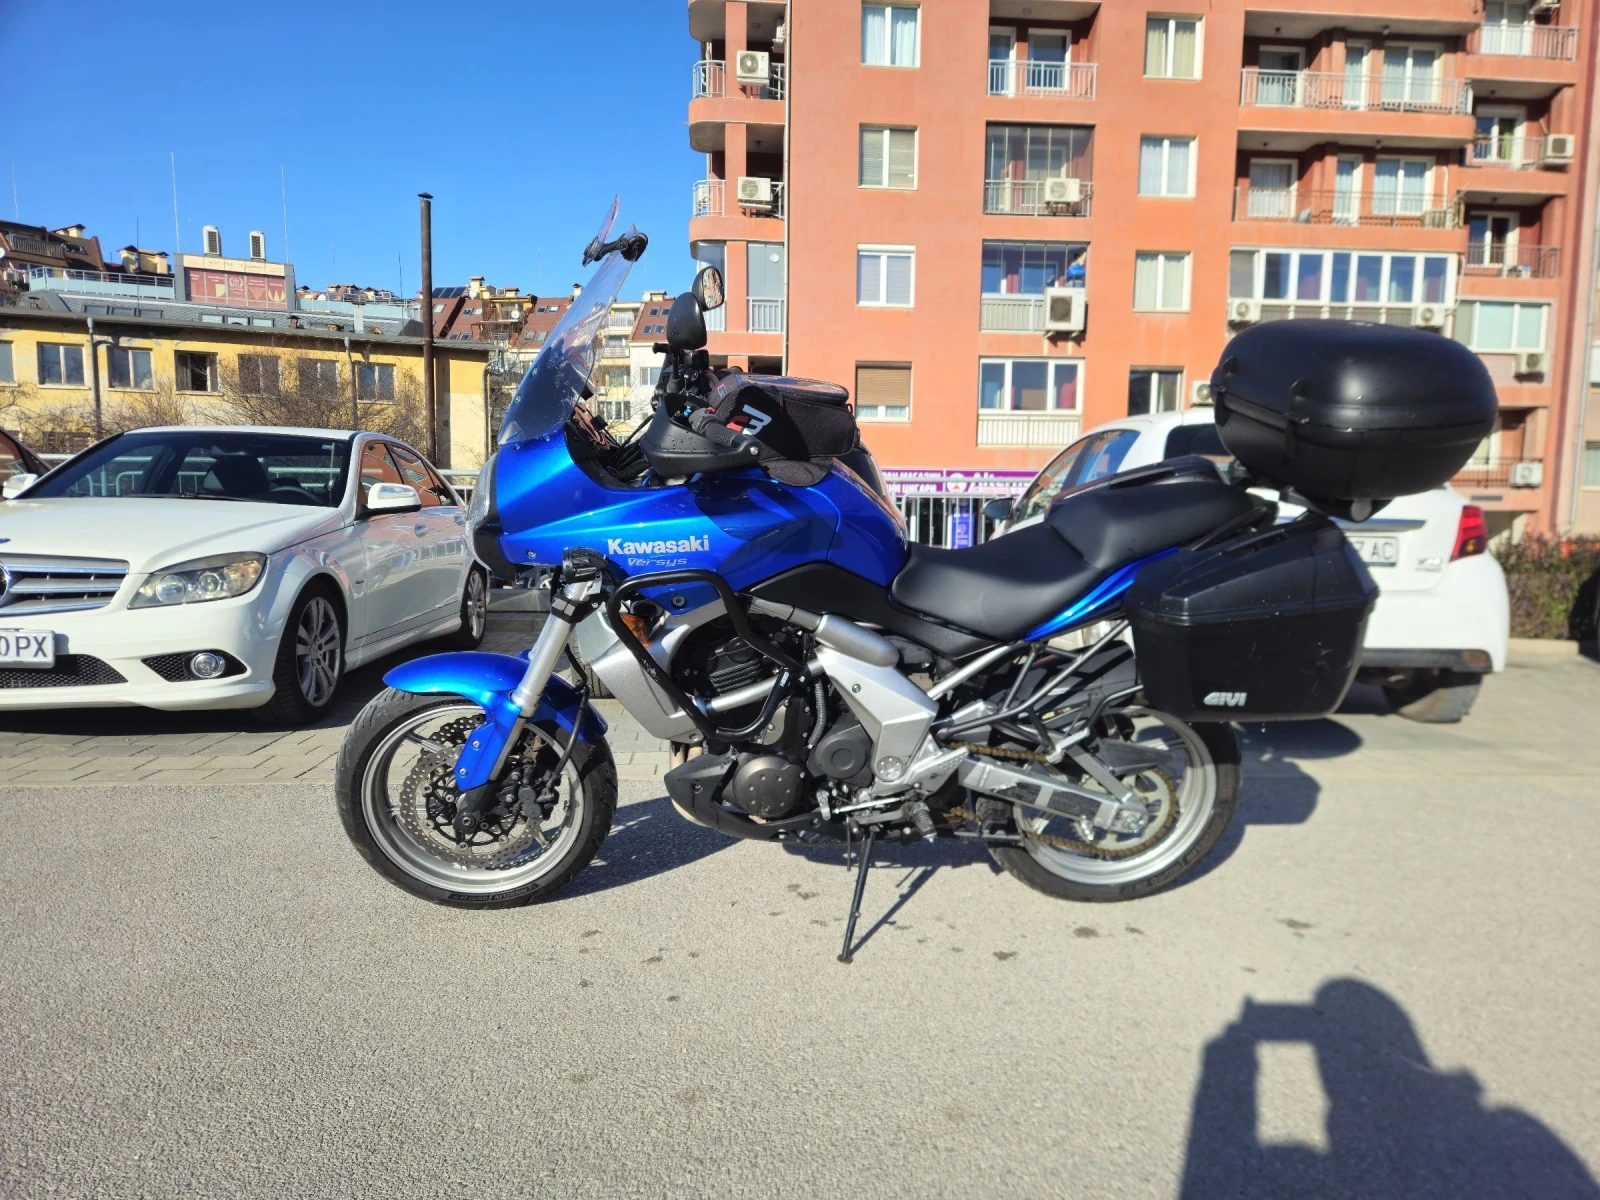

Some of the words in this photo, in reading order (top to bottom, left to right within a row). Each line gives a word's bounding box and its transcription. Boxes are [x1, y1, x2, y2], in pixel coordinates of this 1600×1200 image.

[607, 535, 709, 555] Kawasaki
[1371, 541, 1393, 559] AC
[627, 557, 688, 567] Versys
[1203, 691, 1247, 707] GIVI
